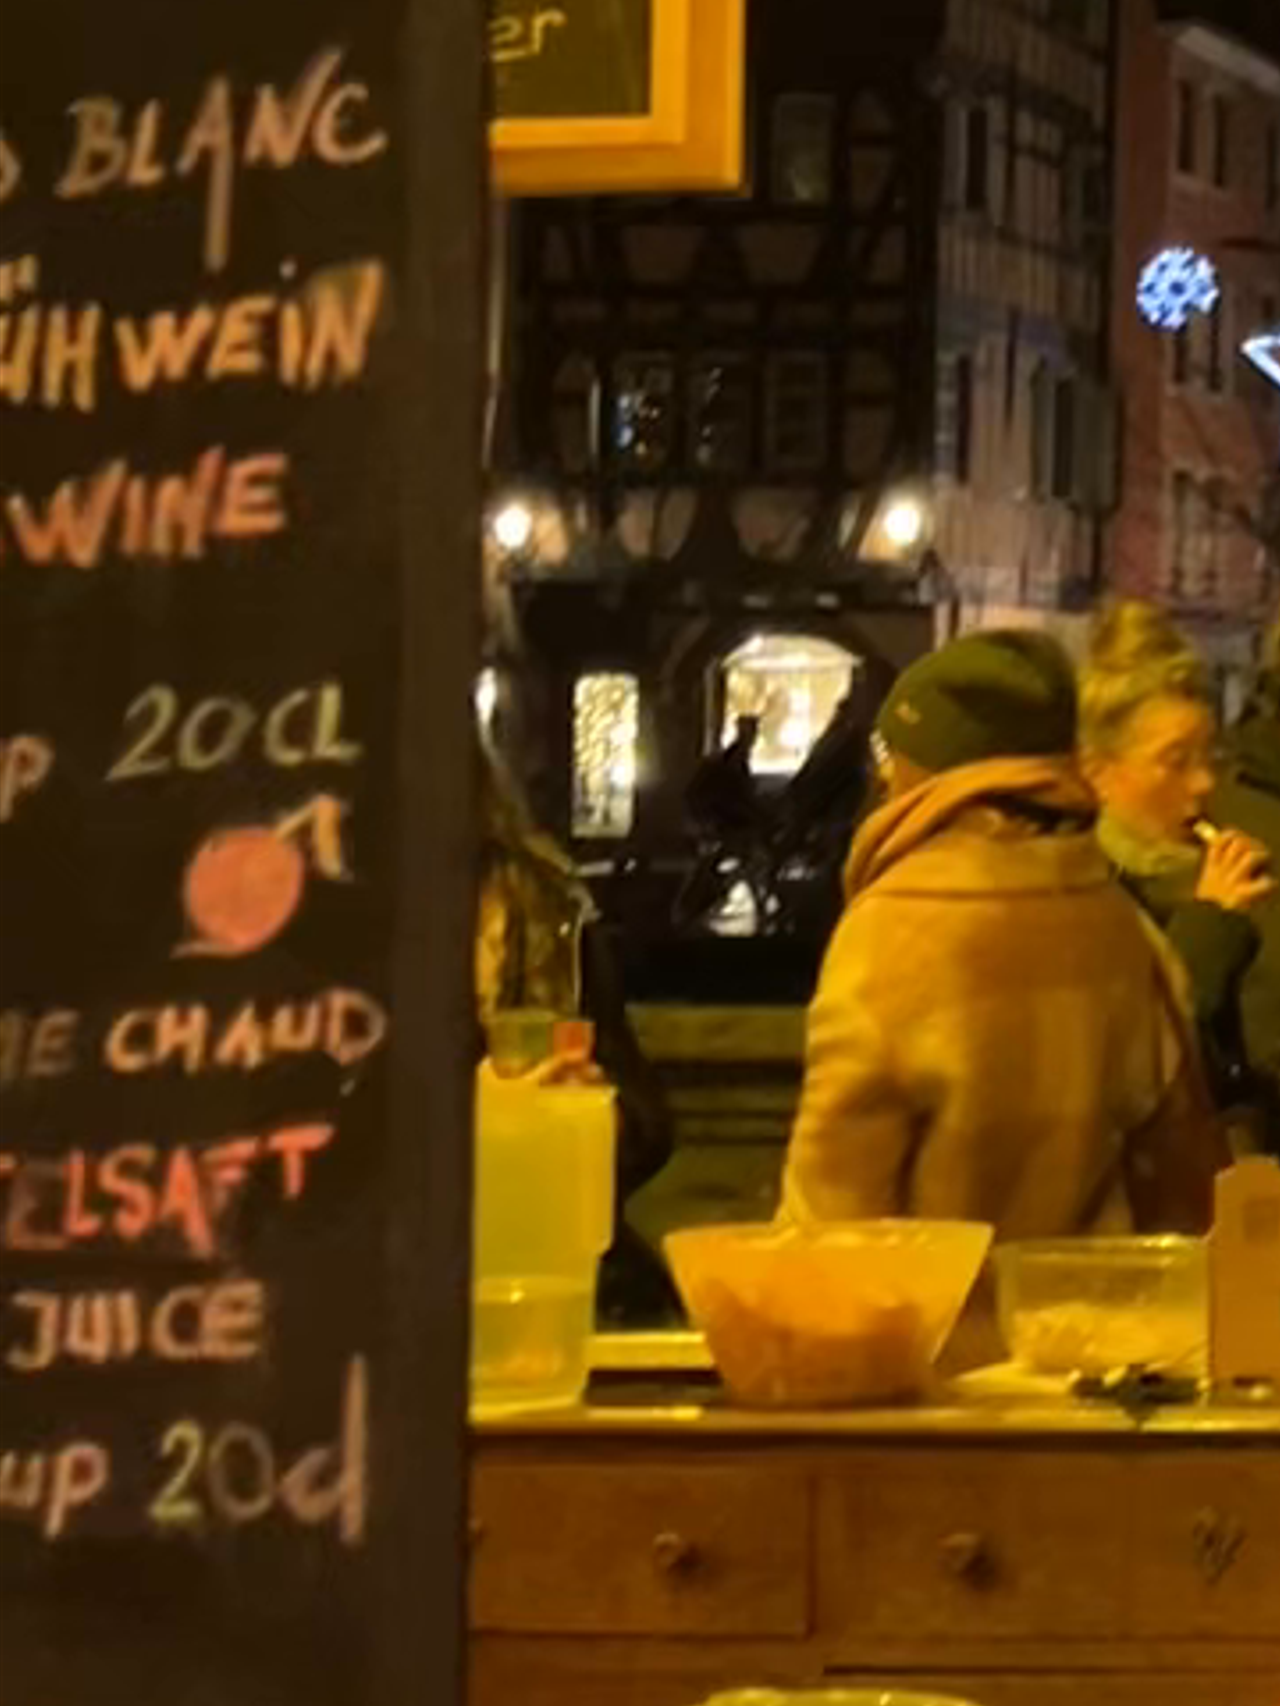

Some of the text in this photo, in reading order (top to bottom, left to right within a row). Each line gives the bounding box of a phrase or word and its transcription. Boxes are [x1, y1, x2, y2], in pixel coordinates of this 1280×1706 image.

[54, 46, 389, 273] BLANC
[6, 443, 289, 569] WINE
[106, 988, 388, 1075] CHAUD
[7, 1279, 265, 1371] JUICE
